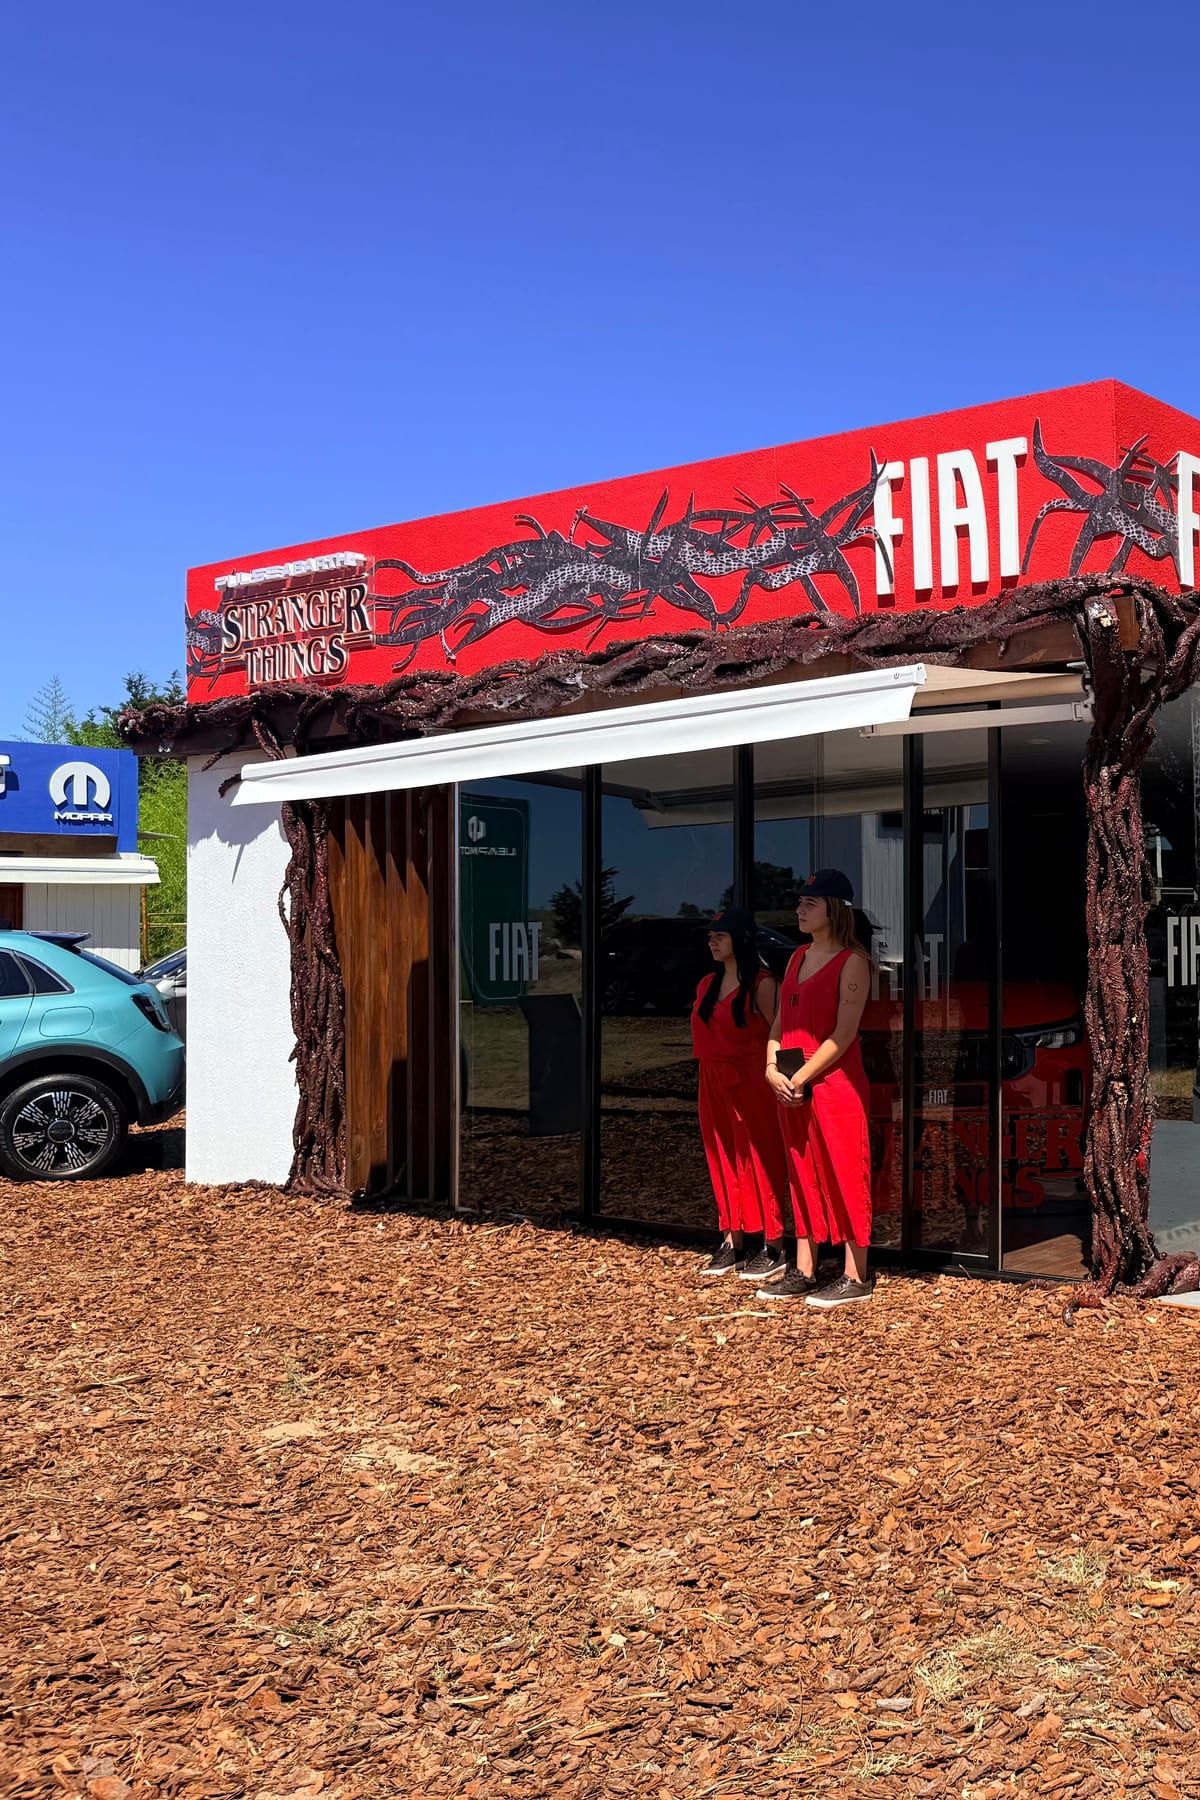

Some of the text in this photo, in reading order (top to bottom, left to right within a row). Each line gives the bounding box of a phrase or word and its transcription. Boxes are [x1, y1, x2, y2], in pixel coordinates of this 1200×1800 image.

[874, 436, 1027, 595] FIAT
[221, 583, 372, 654] STRANGER
[245, 634, 347, 684] THINGS
[54, 811, 113, 822] MOPAR
[489, 922, 542, 982] FIAT
[928, 1089, 949, 1105] FIAT
